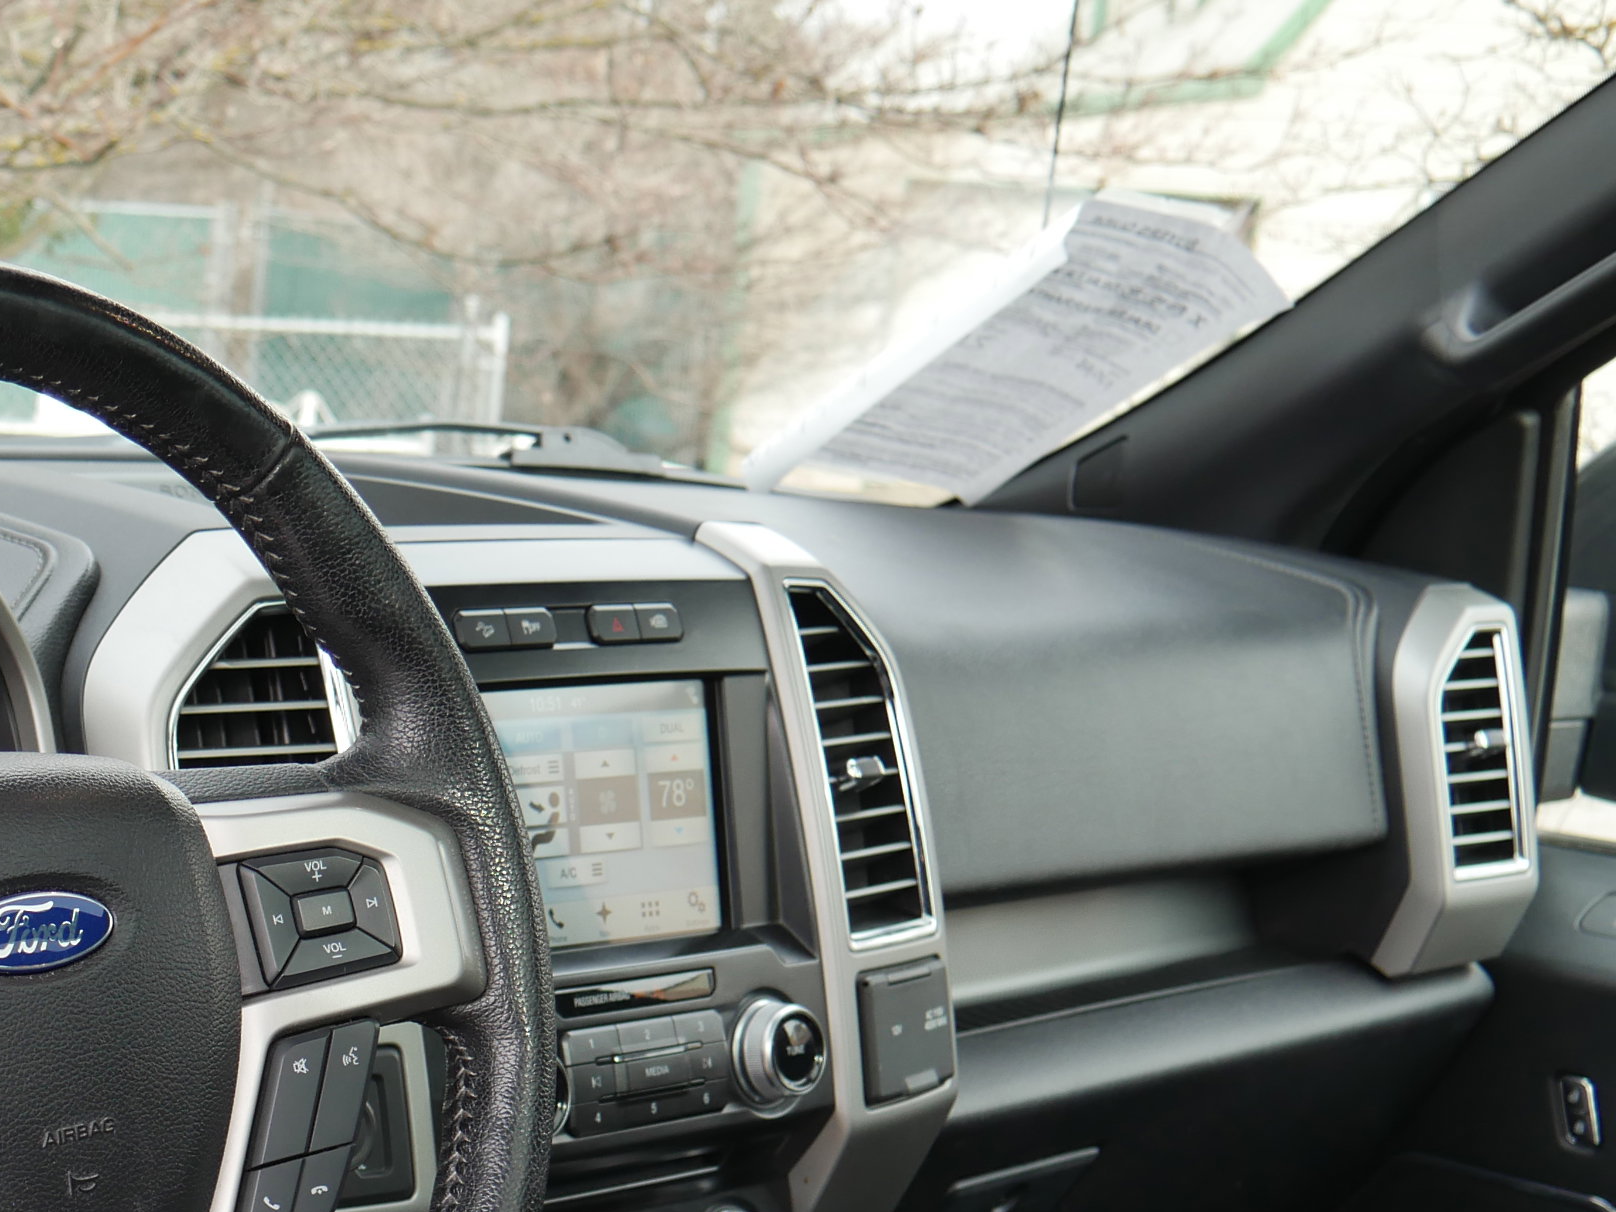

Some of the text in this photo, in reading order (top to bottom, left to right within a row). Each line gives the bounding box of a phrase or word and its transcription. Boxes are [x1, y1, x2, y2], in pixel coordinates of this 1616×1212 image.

[659, 722, 684, 735] DUAL
[304, 860, 327, 872] VOL
[322, 905, 332, 915] M
[323, 942, 346, 954] VOL
[645, 1065, 670, 1077] MEDIA
[703, 1092, 710, 1104] 6
[651, 1102, 657, 1114] 5
[595, 1112, 601, 1123] 4
[42, 1117, 116, 1148] AIRBAG
